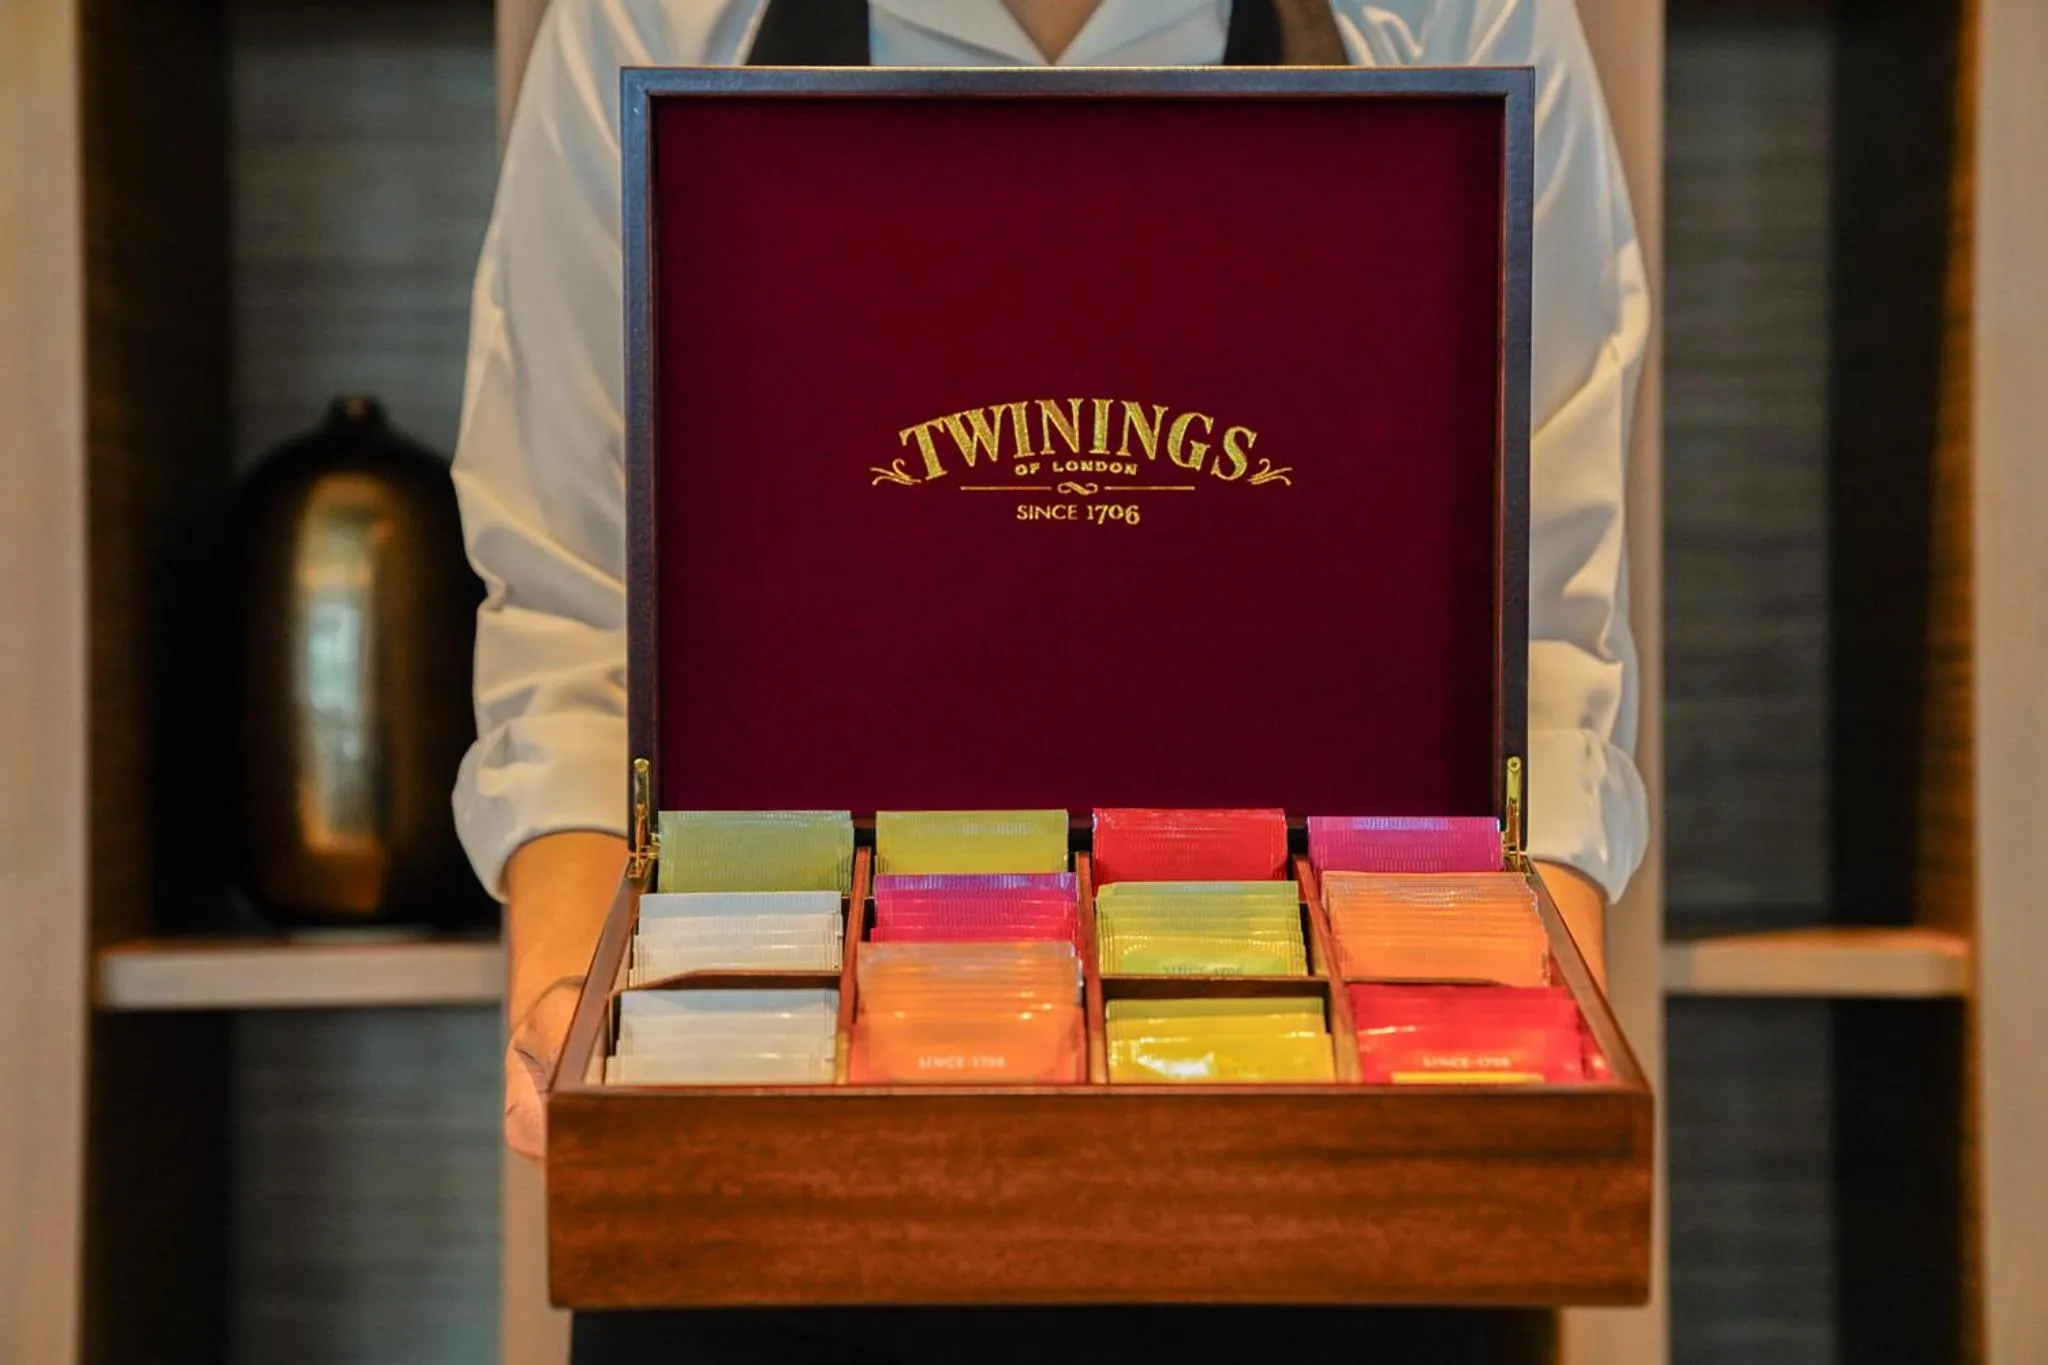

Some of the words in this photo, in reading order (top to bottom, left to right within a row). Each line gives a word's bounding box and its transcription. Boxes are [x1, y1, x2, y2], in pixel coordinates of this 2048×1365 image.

[898, 397, 1259, 481] TWININGS
[1014, 463, 1040, 476] OF
[1052, 461, 1139, 475] LONDON
[1016, 504, 1078, 521] SINCE
[1085, 504, 1141, 525] 1706
